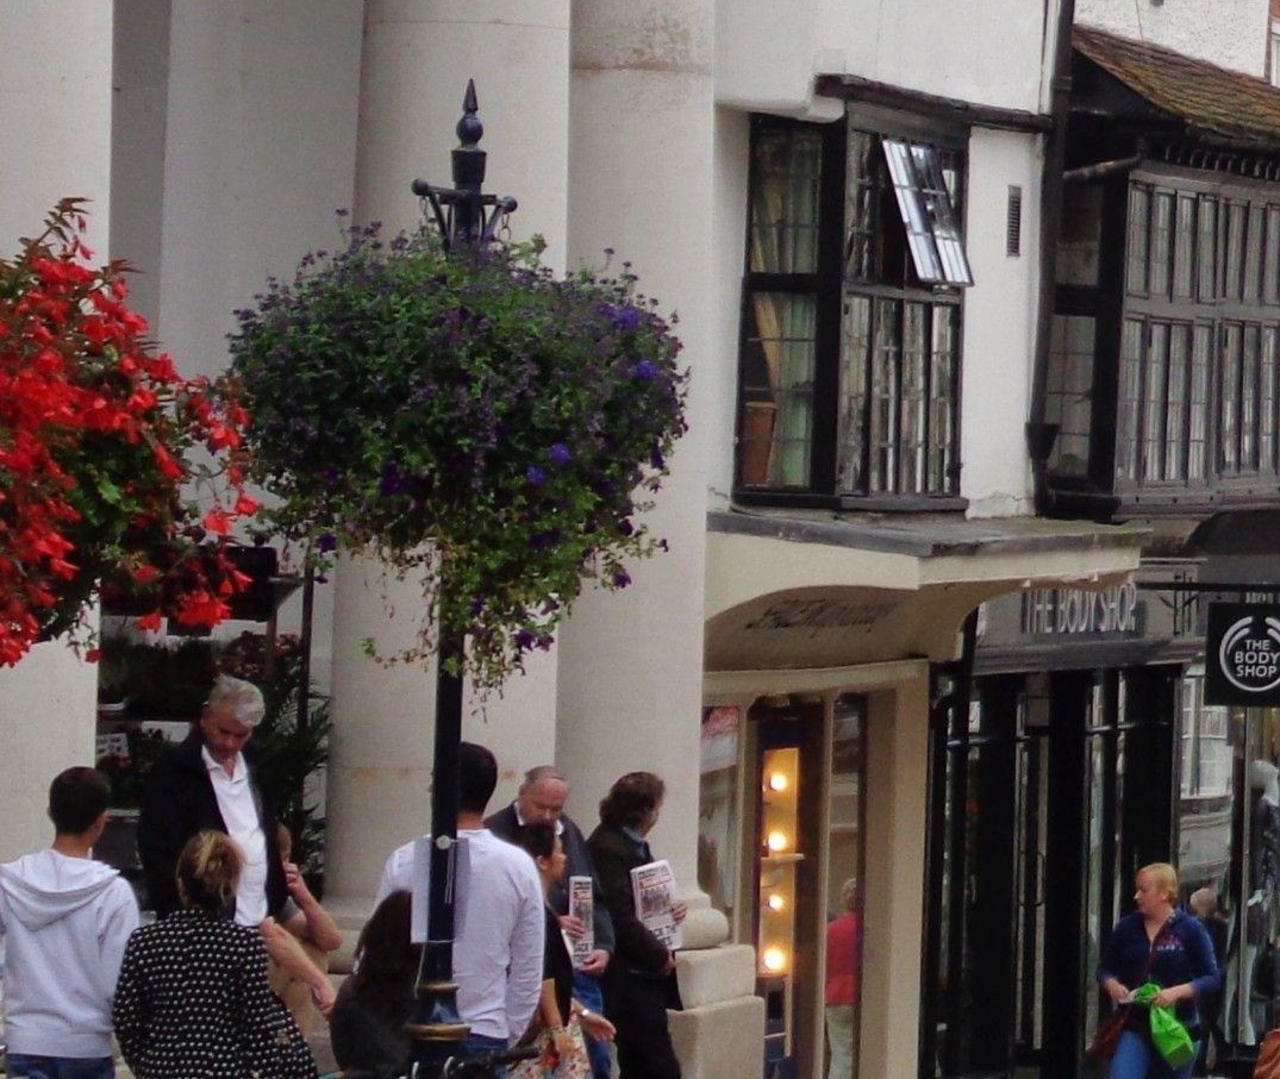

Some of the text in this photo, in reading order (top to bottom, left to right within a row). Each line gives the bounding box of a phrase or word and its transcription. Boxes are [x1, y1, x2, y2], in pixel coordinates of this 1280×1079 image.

[1023, 582, 1138, 634] THE BODY SHOP
[1244, 639, 1271, 651] THE
[1234, 651, 1280, 665] BODY
[1235, 665, 1278, 678] SHOP
